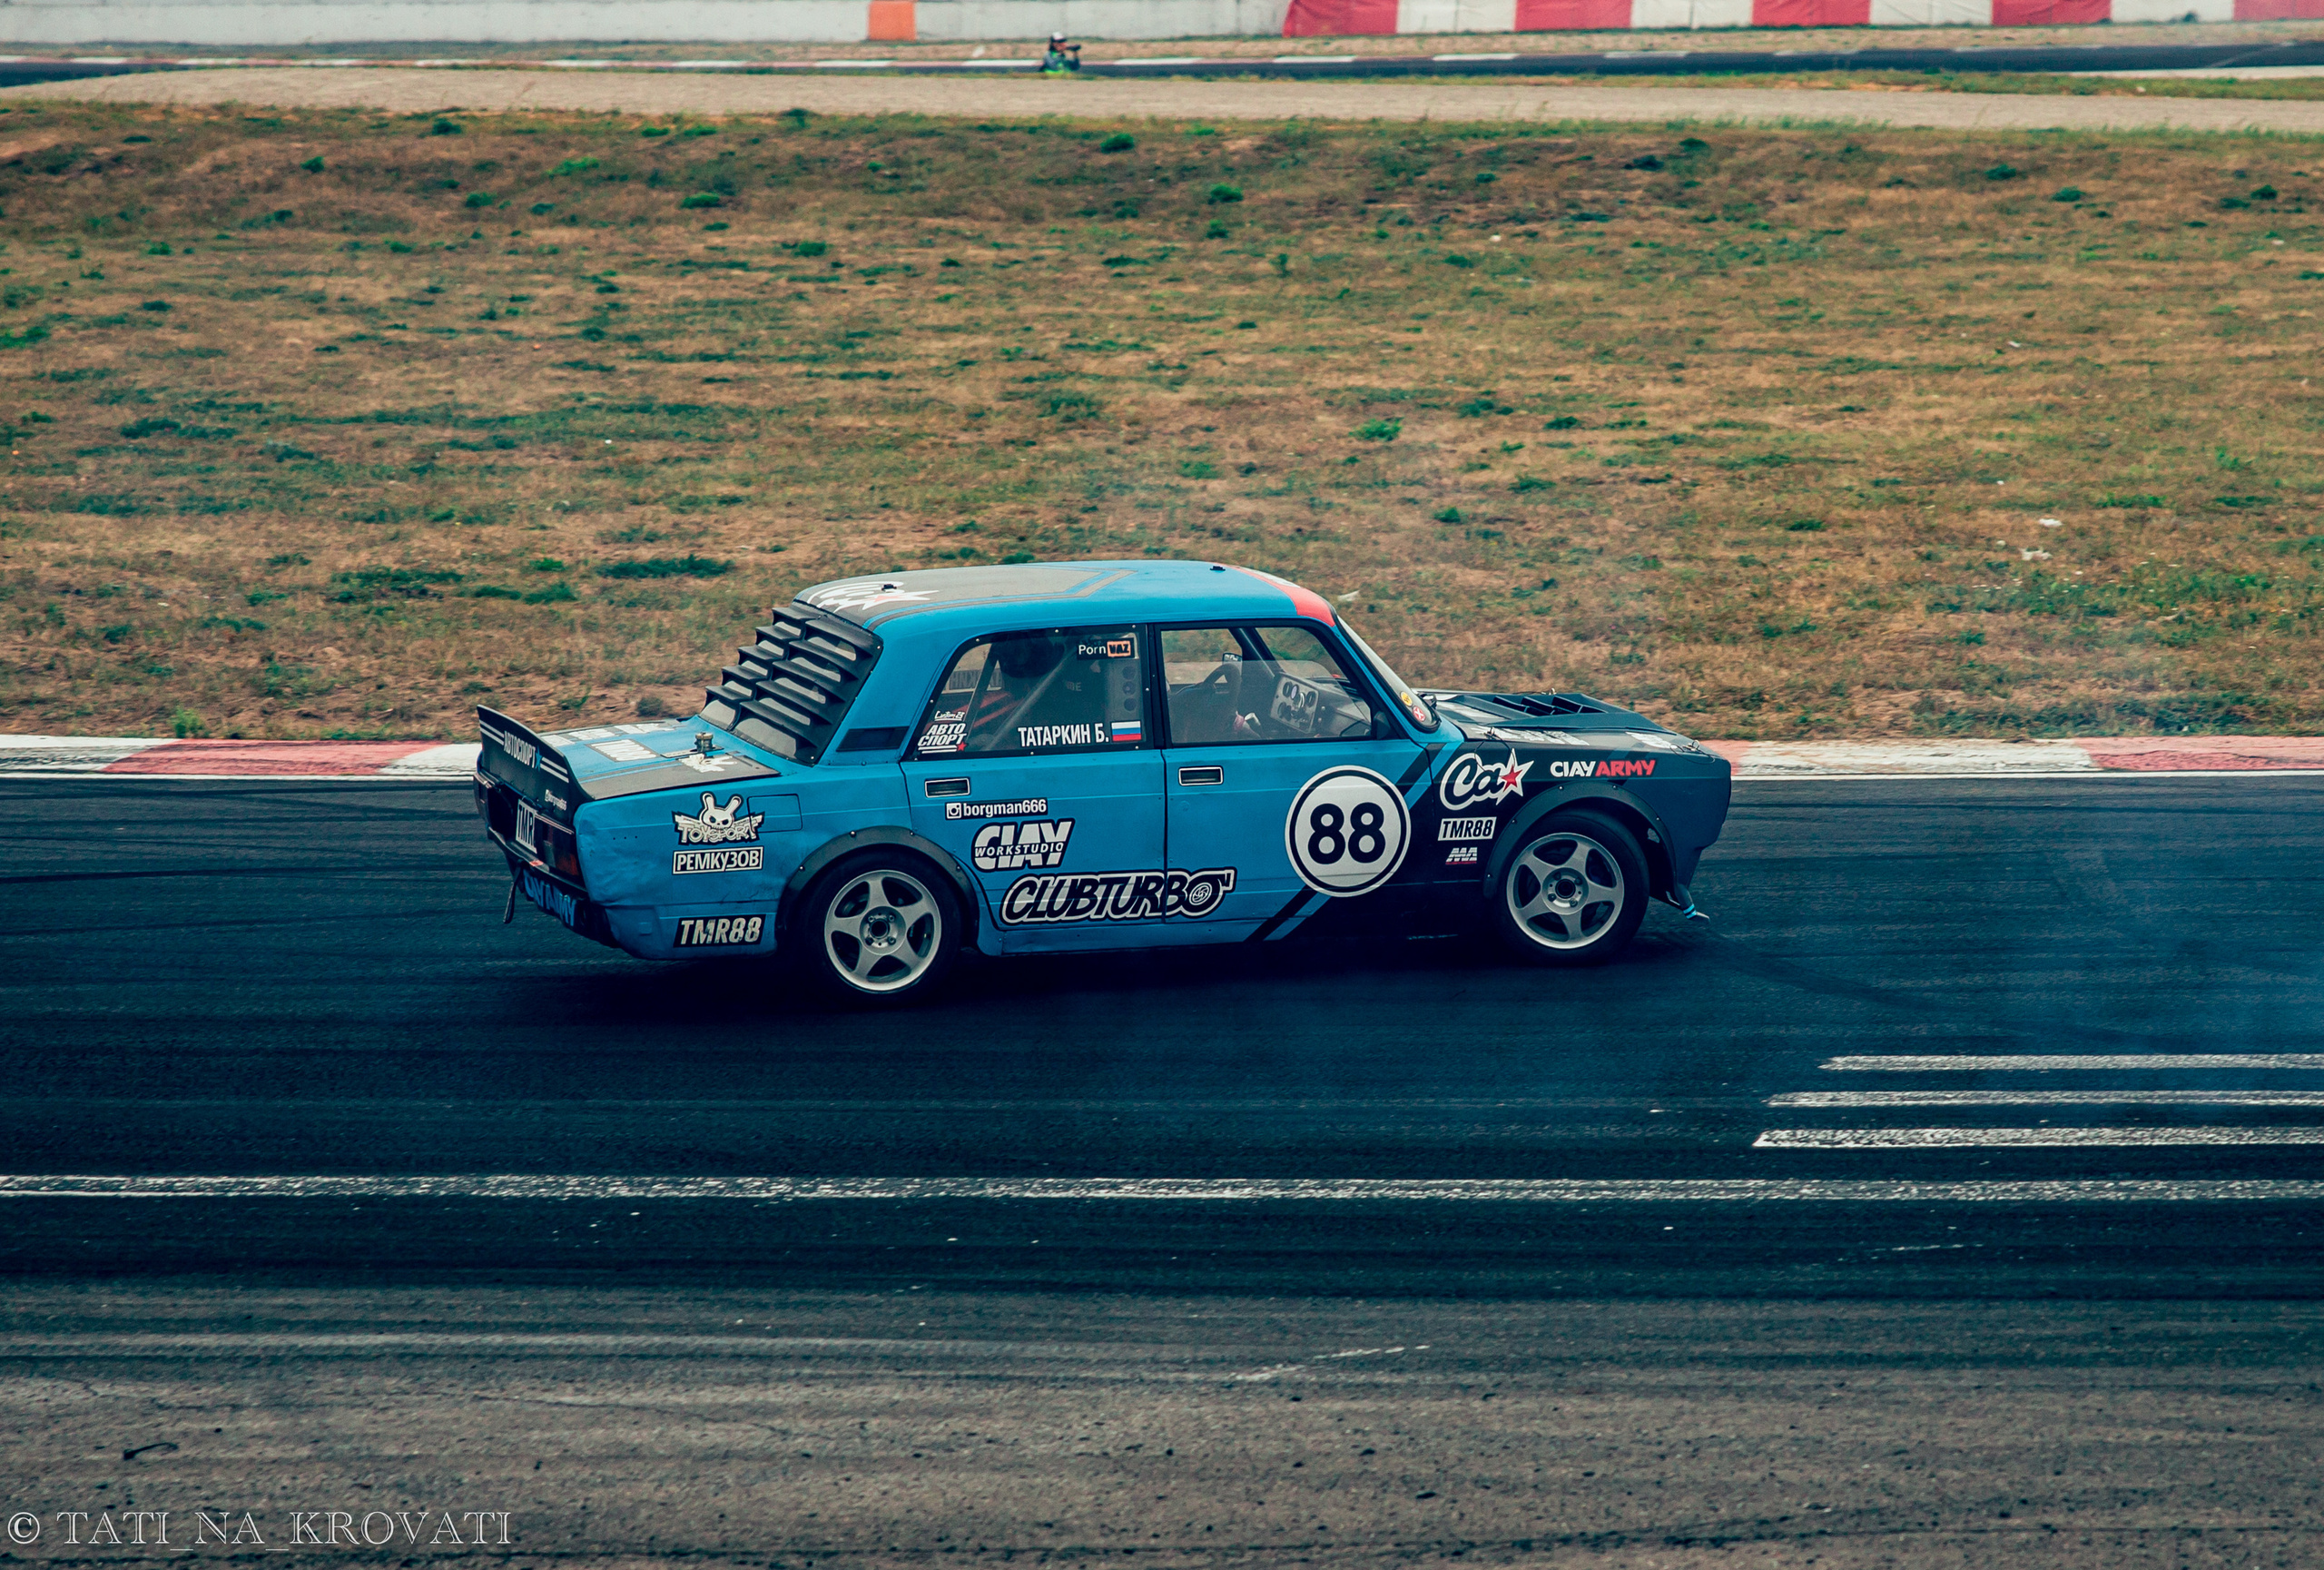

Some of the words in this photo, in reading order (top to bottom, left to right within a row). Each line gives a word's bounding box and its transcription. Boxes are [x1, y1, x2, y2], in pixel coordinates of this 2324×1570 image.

[917, 733, 968, 746] СПОРТ
[926, 723, 967, 736] АВТО
[1018, 725, 1091, 747] ТАТАРКИН
[1095, 723, 1109, 743] Б.
[962, 799, 1048, 817] borgman666
[677, 819, 761, 844] TOYSPORT
[1307, 802, 1386, 865] 88
[1442, 819, 1493, 838] TMR88
[974, 842, 1065, 857] WORKSTUDIO
[676, 850, 760, 872] РЕМКУЗОВ
[1002, 870, 1233, 922] CLUBTURBO
[680, 916, 763, 945] TMR88
